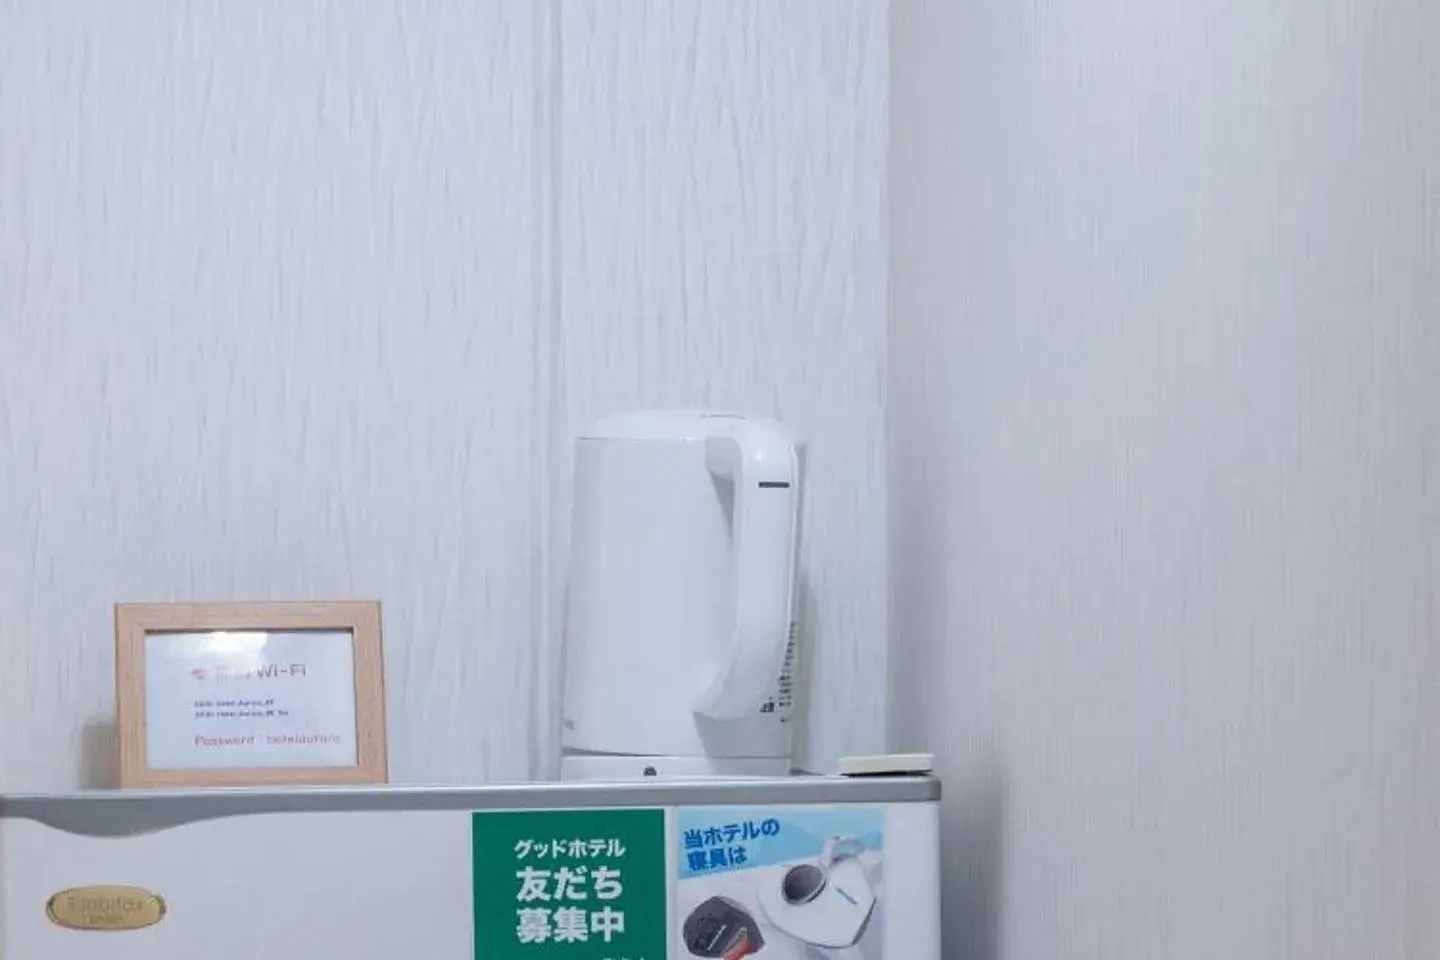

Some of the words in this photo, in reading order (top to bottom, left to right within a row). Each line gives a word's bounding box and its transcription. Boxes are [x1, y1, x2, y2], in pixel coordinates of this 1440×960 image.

[514, 838, 627, 860] グッドホテル
[684, 818, 780, 849] 当ホテルの
[516, 866, 623, 901] 友だち
[516, 906, 625, 943] 募集中
